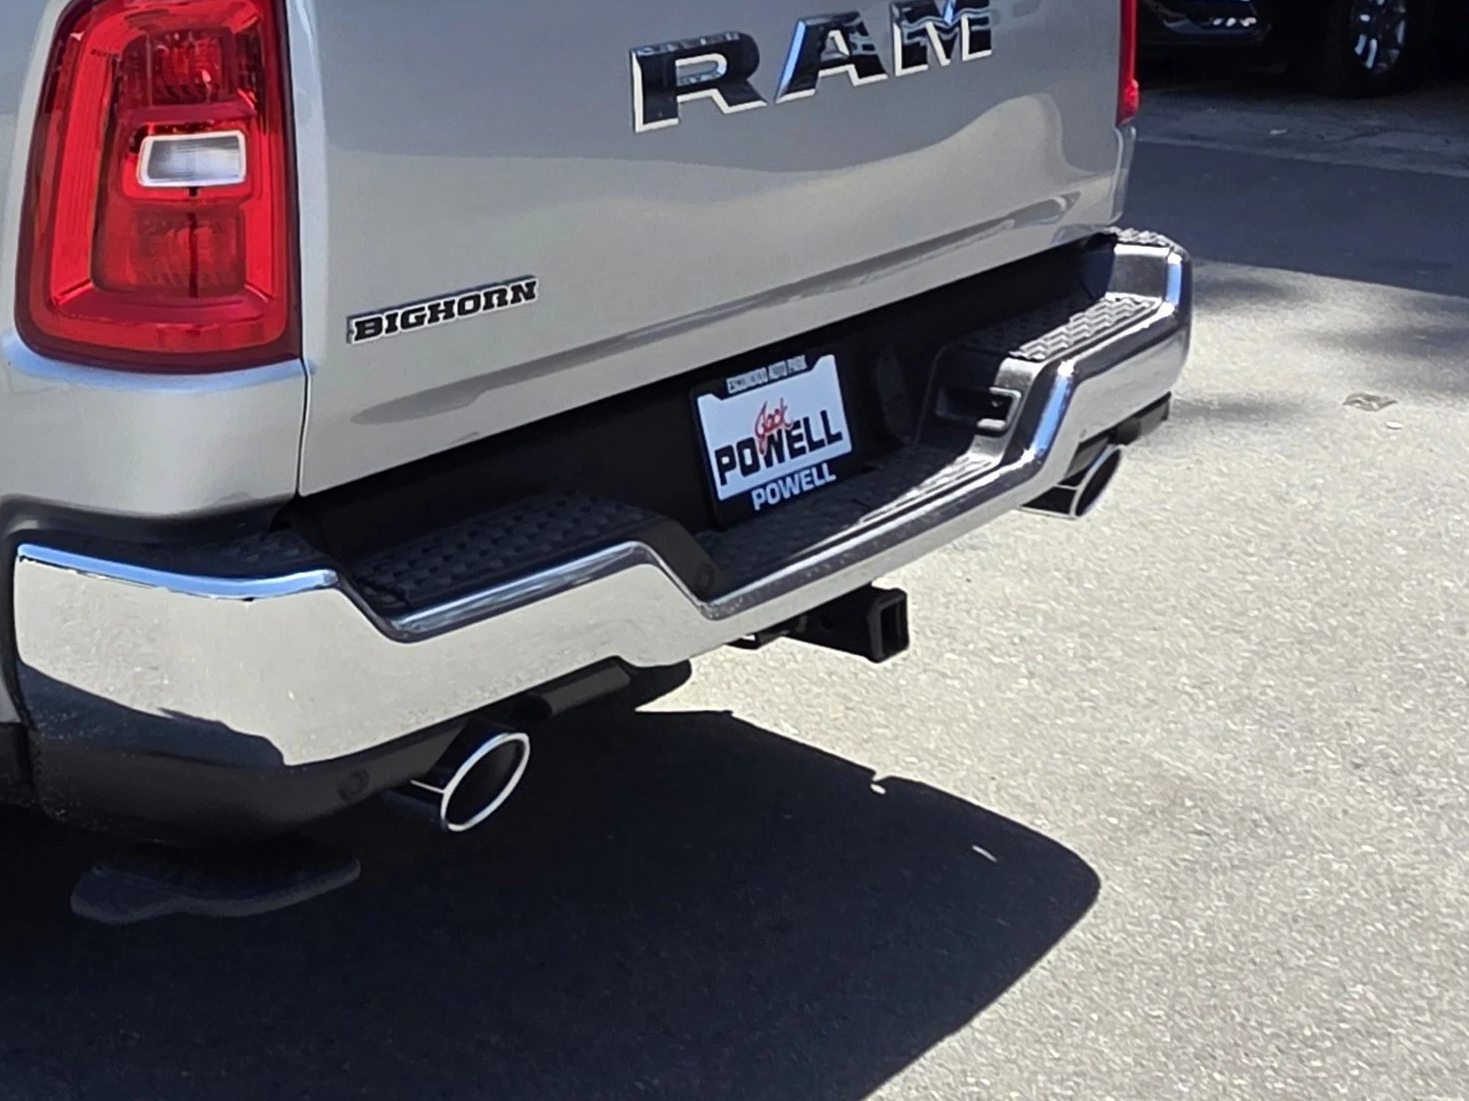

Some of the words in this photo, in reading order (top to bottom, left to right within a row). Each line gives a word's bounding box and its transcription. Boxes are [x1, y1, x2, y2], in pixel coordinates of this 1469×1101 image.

[347, 275, 539, 344] BIGHORN
[715, 409, 843, 487] POWELL
[751, 462, 837, 511] POWELL
